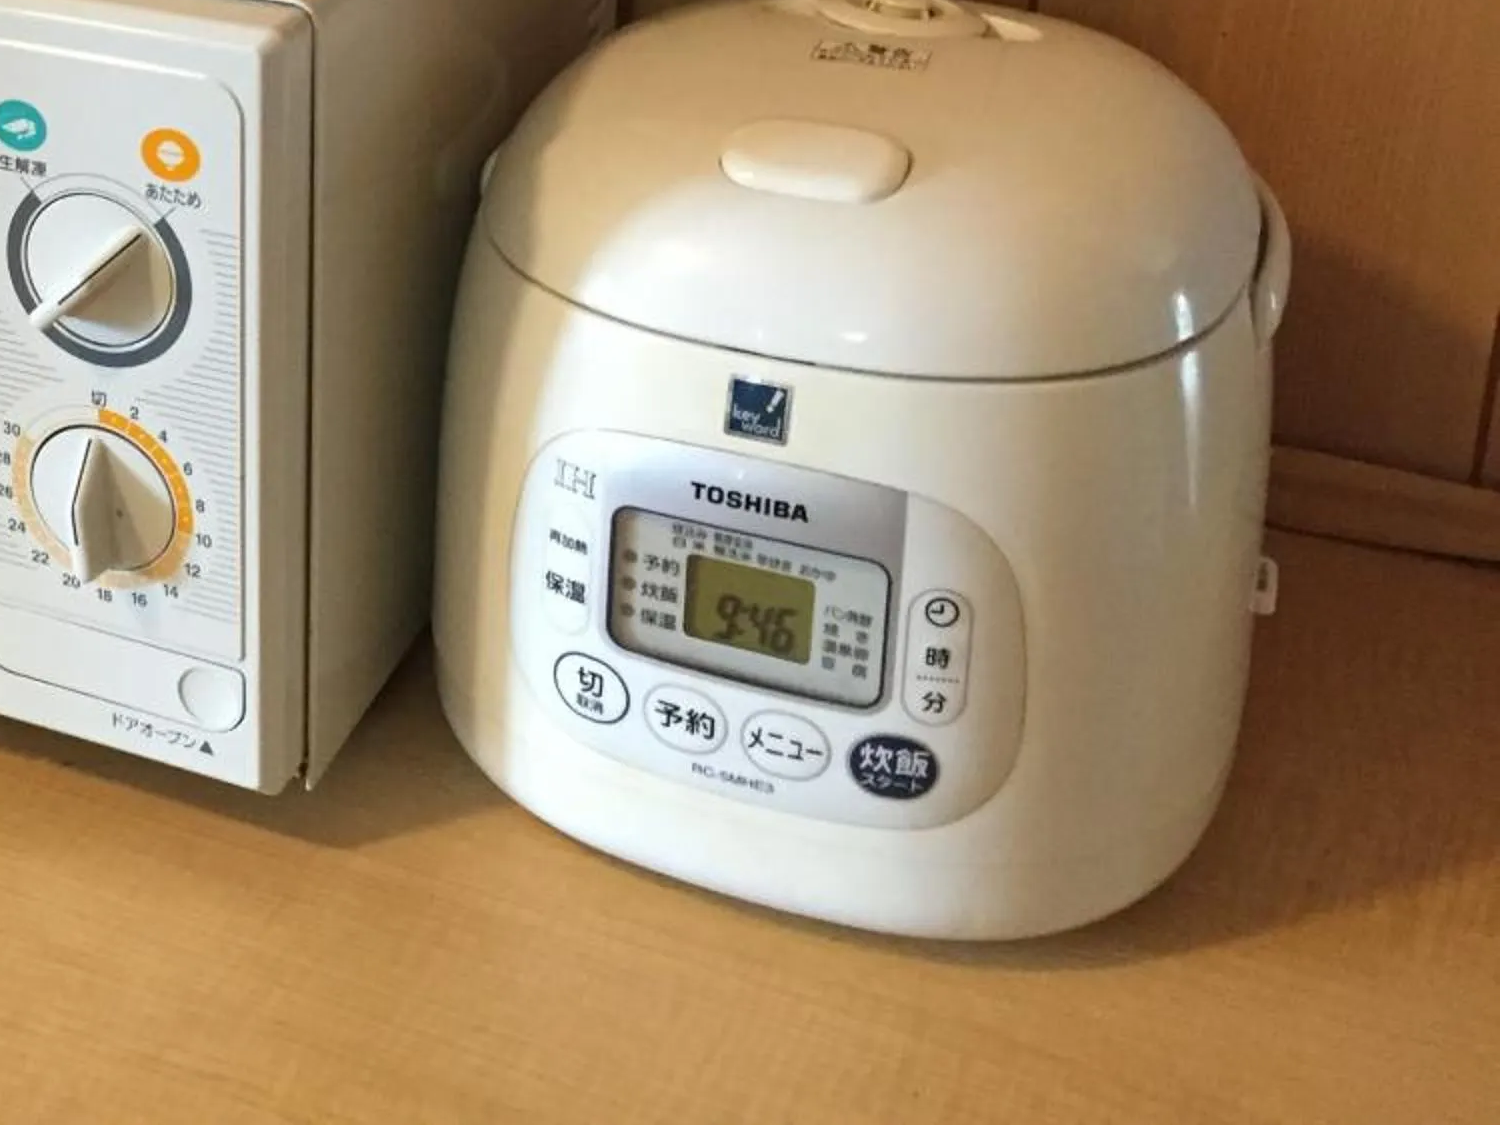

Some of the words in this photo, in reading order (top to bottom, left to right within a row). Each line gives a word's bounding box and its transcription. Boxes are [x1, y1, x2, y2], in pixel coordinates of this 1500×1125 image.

[145, 183, 202, 208] あたため
[130, 407, 139, 420] 2
[3, 421, 21, 437] 30
[159, 430, 168, 443] 4
[183, 462, 193, 476] 6
[195, 499, 205, 512] 8
[690, 481, 809, 524] TOSHIBA
[8, 519, 26, 534] 24
[196, 534, 212, 548] 10
[31, 550, 49, 565] 22
[185, 563, 201, 579] 12
[62, 574, 81, 589] 20
[545, 570, 586, 605] 保温
[163, 583, 179, 598] 14
[131, 592, 147, 608] 16
[925, 646, 950, 670] 時
[577, 666, 604, 699] 切
[922, 691, 947, 715] 分
[654, 699, 716, 741] 予約
[112, 712, 197, 749] ドアオープン
[748, 727, 824, 762] メニュー
[859, 744, 931, 779] 炊飯
[860, 774, 925, 793] スタート
